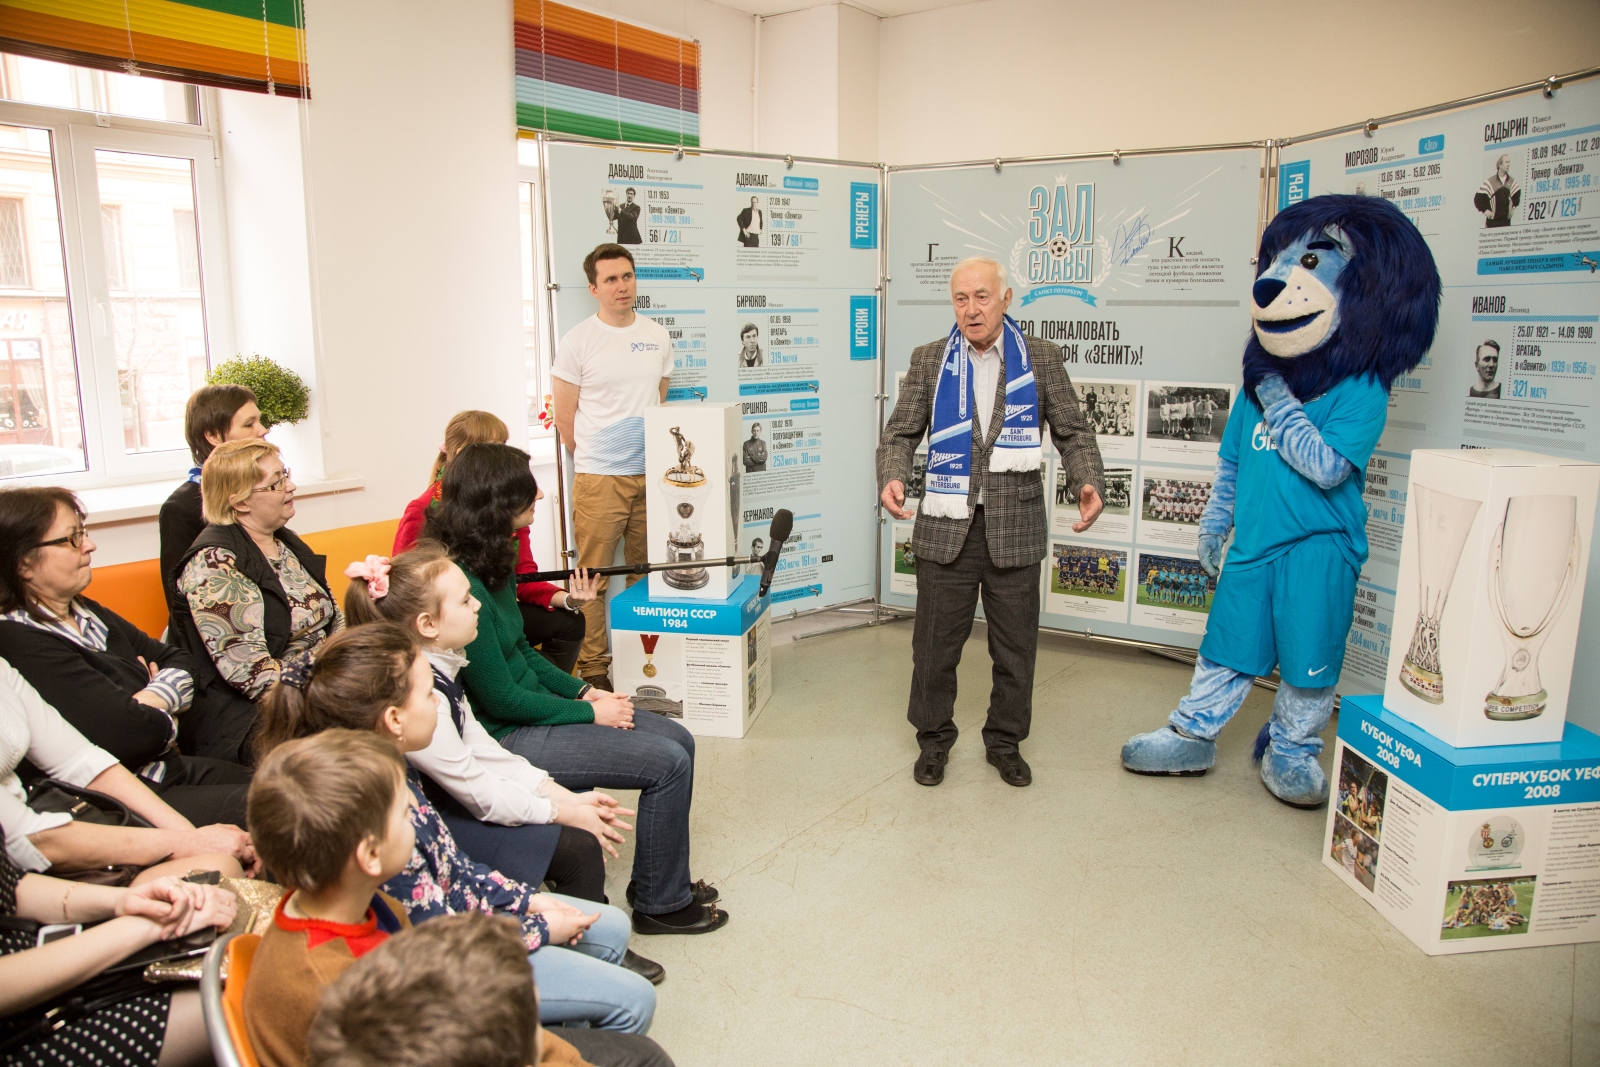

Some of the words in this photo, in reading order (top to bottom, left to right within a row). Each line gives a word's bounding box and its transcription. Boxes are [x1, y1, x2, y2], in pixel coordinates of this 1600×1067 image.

[1484, 117, 1528, 143] САДЫРИН
[1532, 116, 1551, 124] Павел
[1532, 123, 1566, 134] Фёдорович
[1532, 146, 1548, 160] 18.09
[1551, 143, 1566, 157] 1942
[1576, 139, 1588, 152] 1.12
[1591, 137, 1600, 150] 20
[1345, 147, 1378, 168] МОРОЗОВ
[1381, 146, 1394, 154] Юрий
[608, 164, 644, 180] ДАВЫДОВ
[1381, 172, 1393, 182] 13.05
[1395, 169, 1405, 180] 1934
[1413, 166, 1426, 177] 15.02
[1428, 163, 1440, 175] 2005
[1531, 167, 1550, 181] Тренер
[1554, 163, 1584, 176] «Зенита»
[736, 173, 768, 188] АДВОКААТ
[1536, 178, 1561, 193] 1983-87,
[1565, 174, 1591, 189] 1995-96
[659, 191, 670, 200] 1953
[1288, 173, 1304, 204] НЕРЫ
[648, 205, 662, 214] Тренер
[770, 211, 783, 219] Тренер
[856, 192, 869, 240] ТРЕНЕРЫ
[1028, 182, 1095, 246] ЗАЛ
[1528, 201, 1547, 220] 262
[1560, 198, 1577, 217] 125
[650, 230, 658, 242] 56
[669, 230, 678, 243] 23
[771, 234, 781, 246] 139
[791, 235, 799, 246] 68
[1028, 248, 1093, 284] СЛАВЫ
[1034, 288, 1083, 297] САНКТ-ПЕТЕРБУРГ
[632, 296, 650, 311] ДКОВ
[737, 295, 766, 307] БИРЮКОВ
[1472, 296, 1506, 313] ИВАНОВ
[771, 328, 787, 336] ВРАТАРЬ
[855, 308, 868, 347] ИГРОКИ
[1041, 320, 1120, 340] ПОЖАЛОВАТЬ
[1517, 326, 1534, 337] 25.07
[1536, 327, 1548, 337] 1921
[1558, 326, 1574, 338] 14.09
[1578, 326, 1593, 338] 1990
[771, 352, 781, 363] 319
[783, 354, 797, 362] МАТЧЕЙ
[1062, 344, 1078, 363] ФК
[1085, 344, 1143, 365] «ЗЕНИТ»!
[1516, 345, 1541, 356] ВРАТАРЬ
[686, 355, 693, 367] 79
[1519, 360, 1546, 371] «Зените»
[1552, 361, 1566, 372] 1939
[1572, 362, 1587, 374] 1956
[1407, 378, 1421, 389] ГОЛОВ
[1513, 379, 1528, 397] 321
[1530, 387, 1547, 399] МАТЧ
[742, 402, 767, 414] ОРШКОВ
[773, 431, 803, 440] ПОЛУЗАЩИТНИК
[773, 455, 784, 467] 253
[801, 452, 808, 464] 30
[1377, 458, 1387, 470] 1941
[930, 480, 960, 488] PETERSBURG
[1366, 473, 1388, 486] АЩИТНИК
[1373, 508, 1388, 520] МАТЧА
[1391, 508, 1396, 522] 6
[776, 559, 786, 571] 363
[632, 606, 688, 618] ЧЕМПИОН
[690, 609, 717, 619] СССР
[662, 618, 688, 628] 1984
[1350, 630, 1362, 646] 384
[1363, 639, 1377, 652] МАТЧА
[1381, 640, 1385, 654] 7
[1501, 704, 1539, 712] COMPETITION
[1361, 720, 1392, 748] КУБОК
[1396, 736, 1422, 768] УЕФА
[1376, 746, 1400, 769] 2008
[1473, 768, 1571, 787] СУПЕРКУБОК
[1575, 765, 1600, 781] УЕФ
[1524, 785, 1561, 799] 2008
